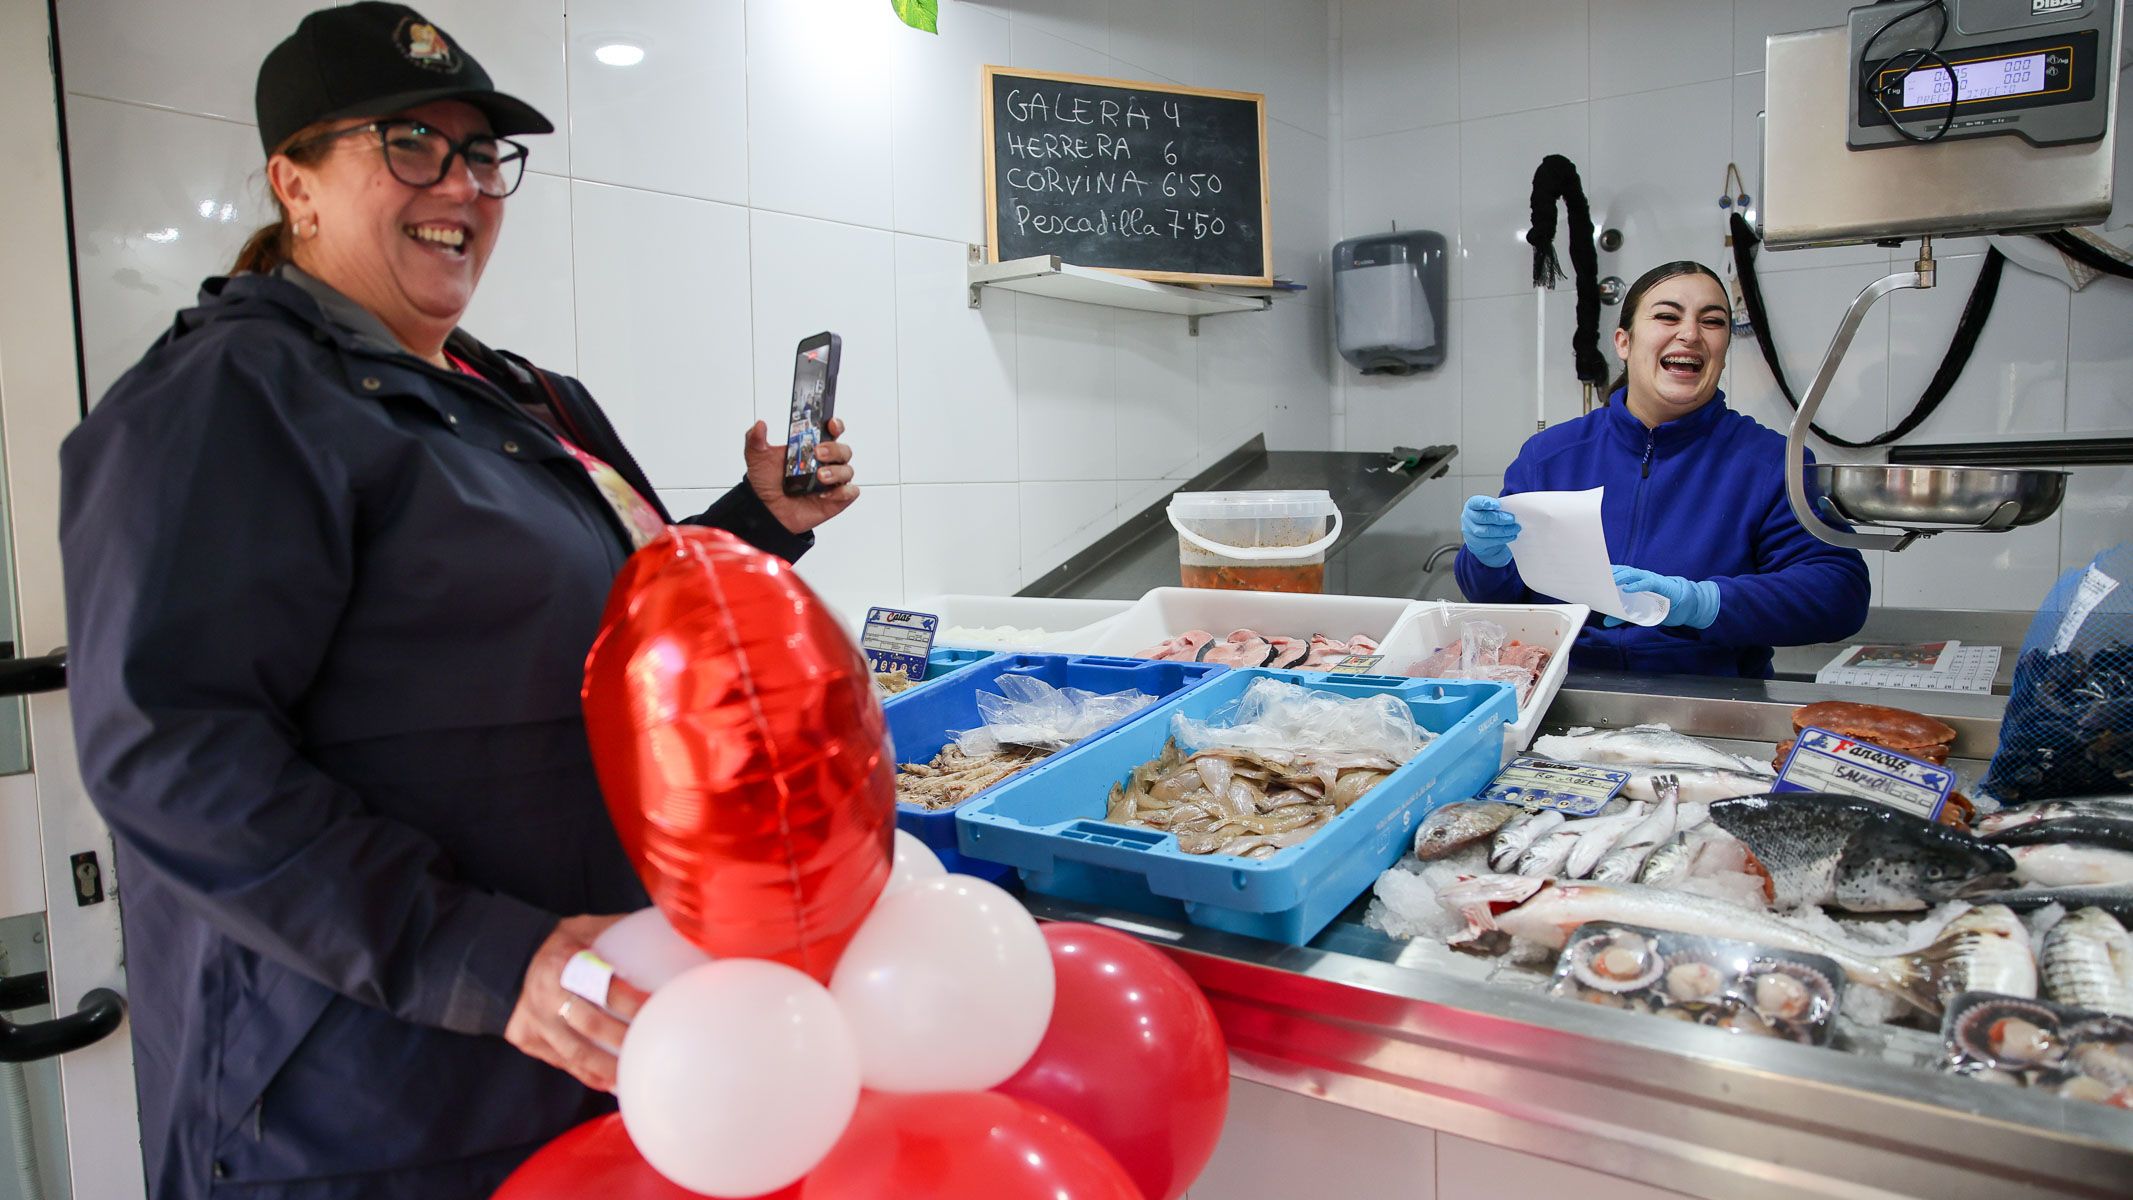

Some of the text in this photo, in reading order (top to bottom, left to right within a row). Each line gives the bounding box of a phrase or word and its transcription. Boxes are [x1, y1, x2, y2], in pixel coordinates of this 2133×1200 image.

[1007, 90, 1180, 130] GALERA 4
[1007, 132, 1178, 166] HERRERA 6
[1007, 167, 1222, 198] CORVINA 6'50
[1016, 205, 1226, 240] Pescadilla 7'50
